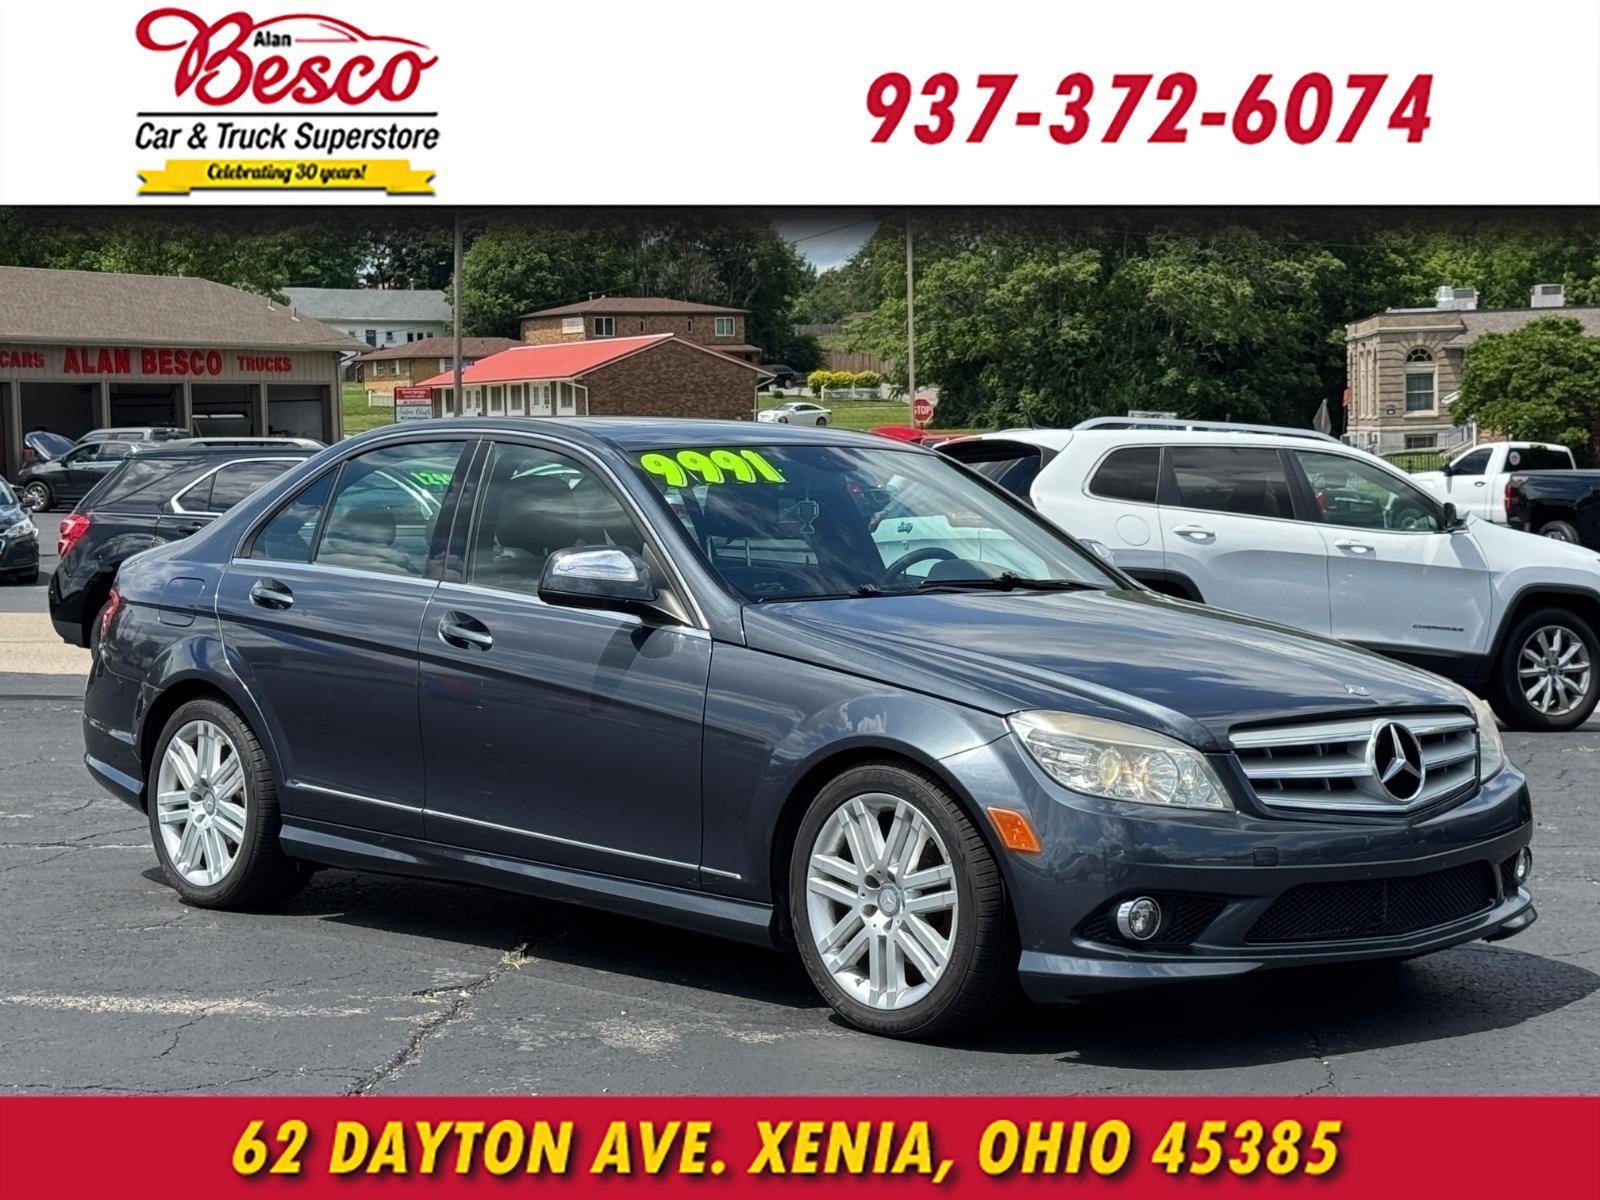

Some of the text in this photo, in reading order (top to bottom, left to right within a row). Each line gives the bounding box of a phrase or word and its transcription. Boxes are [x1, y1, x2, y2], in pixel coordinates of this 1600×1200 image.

[0, 350, 45, 369] CARS
[63, 347, 223, 376] ALAN BESCO
[236, 355, 293, 372] TRUCKS
[640, 449, 787, 488] 9991
